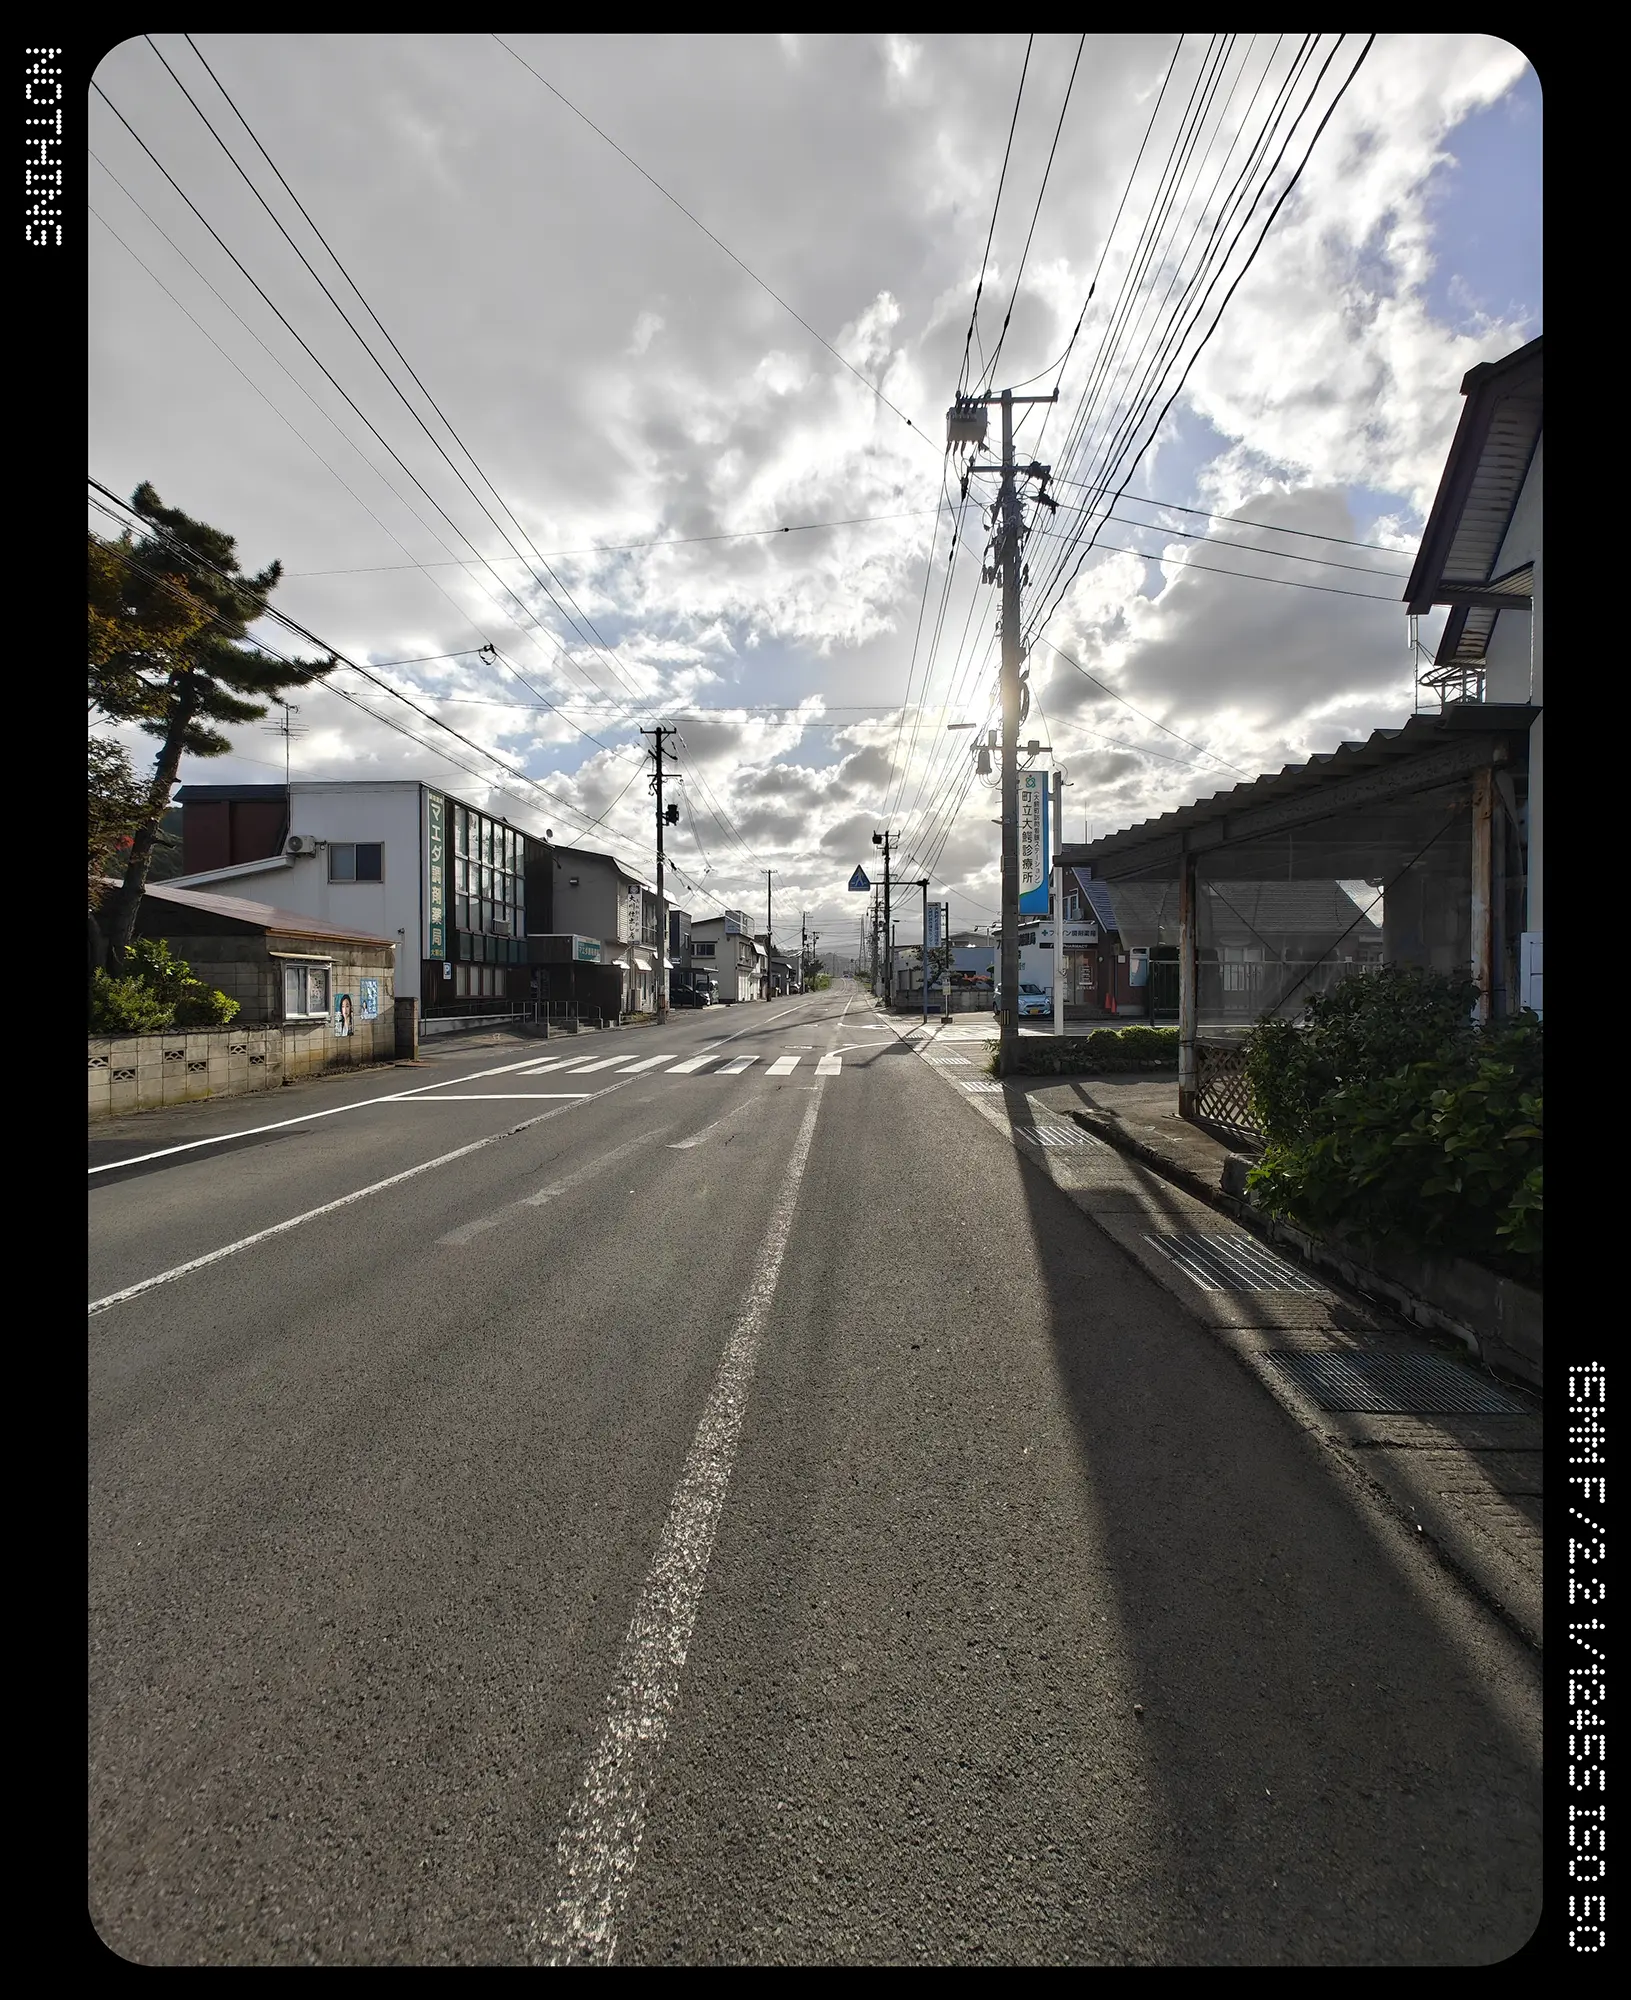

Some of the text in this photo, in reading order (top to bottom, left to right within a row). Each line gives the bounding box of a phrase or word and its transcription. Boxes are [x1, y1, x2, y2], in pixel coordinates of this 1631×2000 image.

[431, 802, 442, 946] マエダ調剤薬局
[1022, 791, 1033, 884] 町立大鰐診療所
